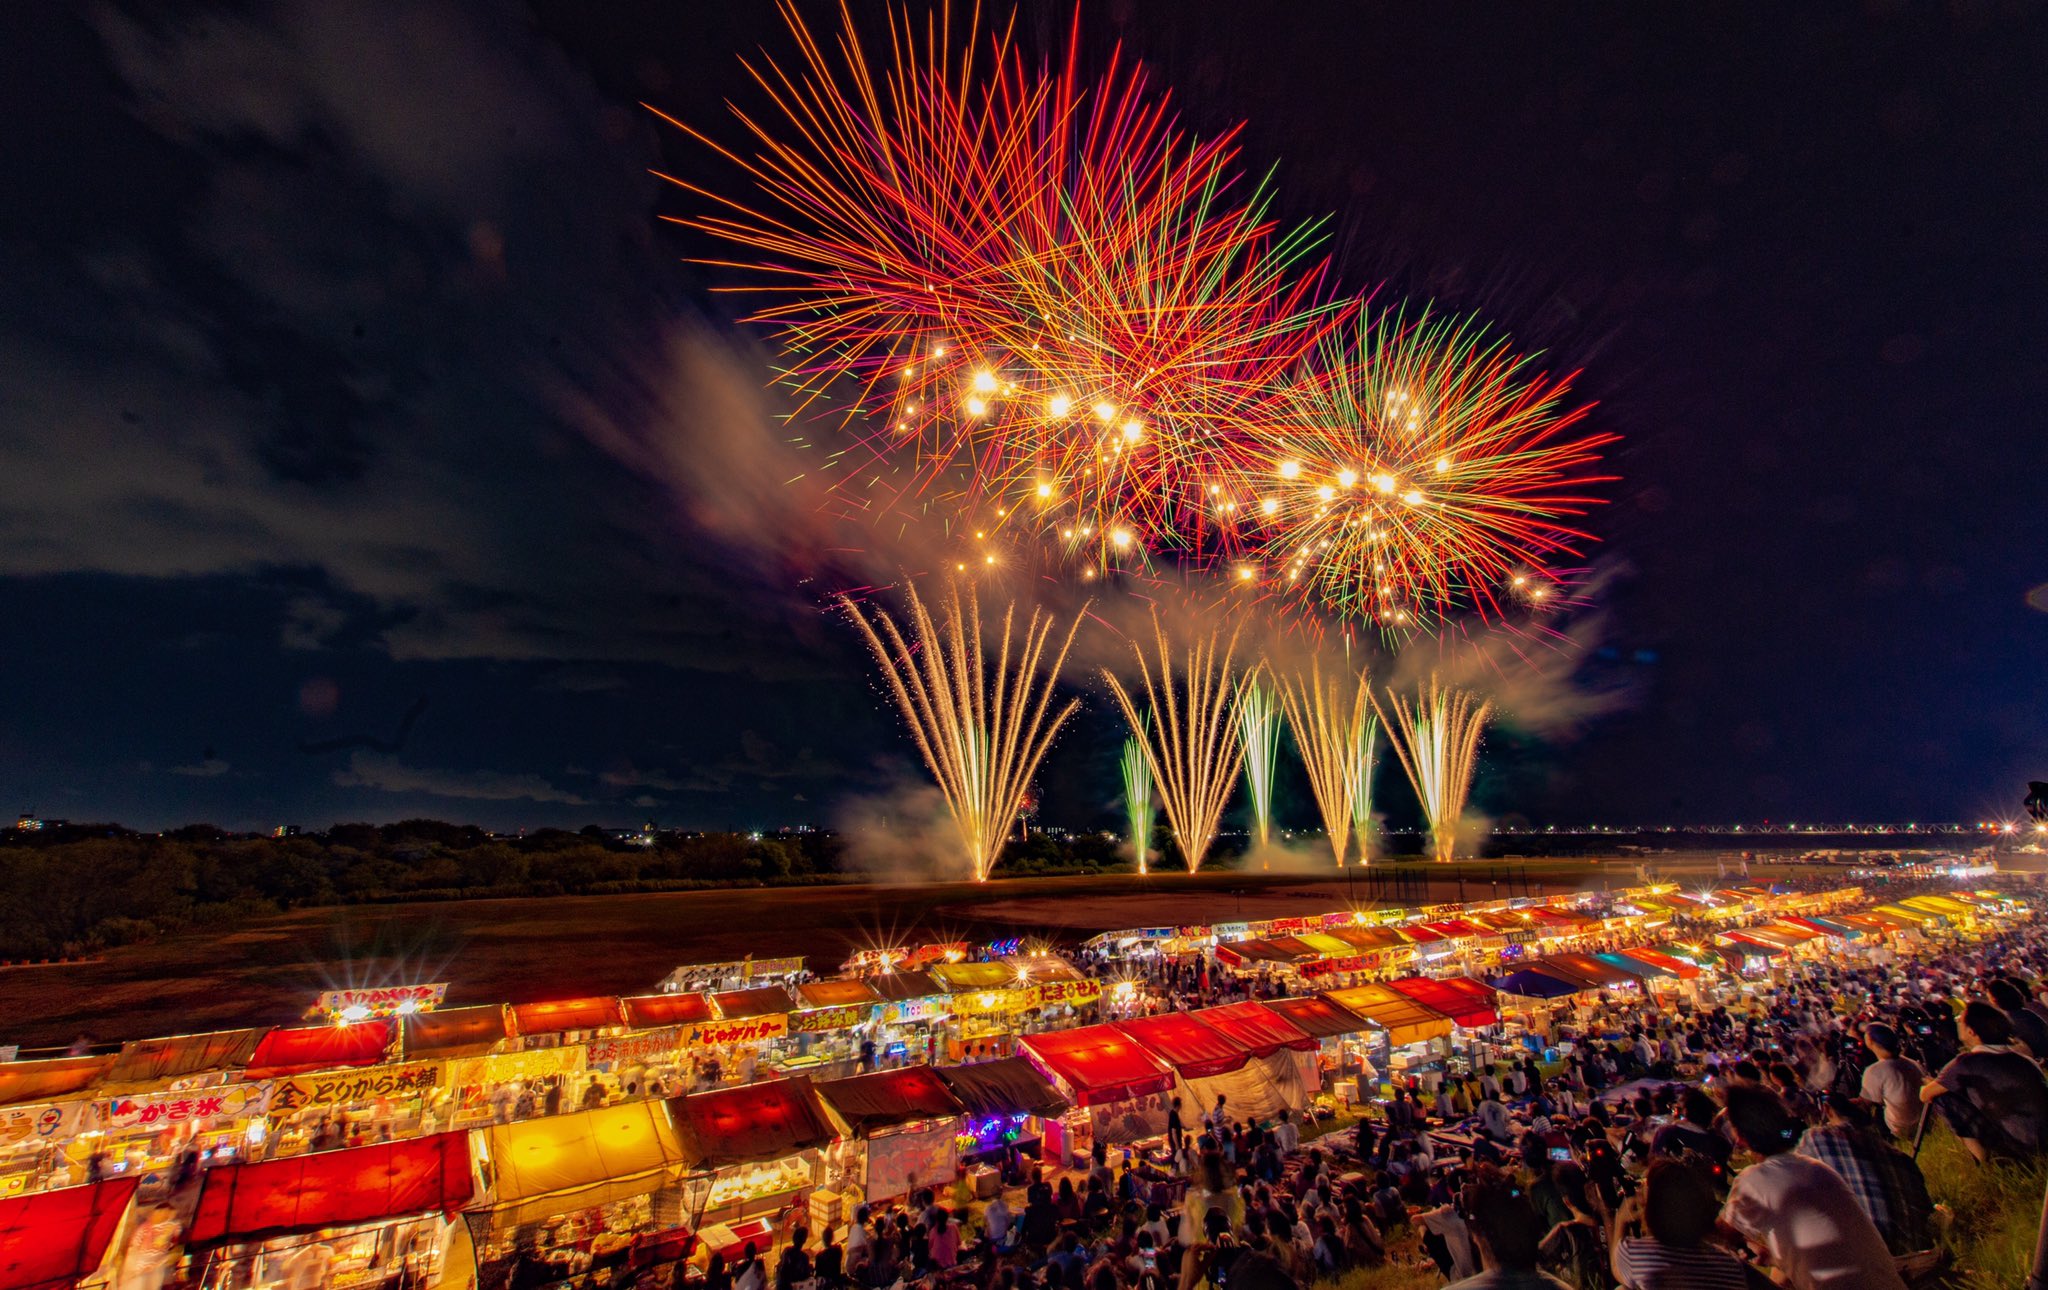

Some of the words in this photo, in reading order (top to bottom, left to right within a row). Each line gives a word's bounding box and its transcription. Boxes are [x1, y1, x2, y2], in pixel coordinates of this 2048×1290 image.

[703, 1021, 782, 1044] じゃがバター
[270, 1066, 438, 1112] 金のとりから本舗
[139, 1096, 223, 1124] かき氷
